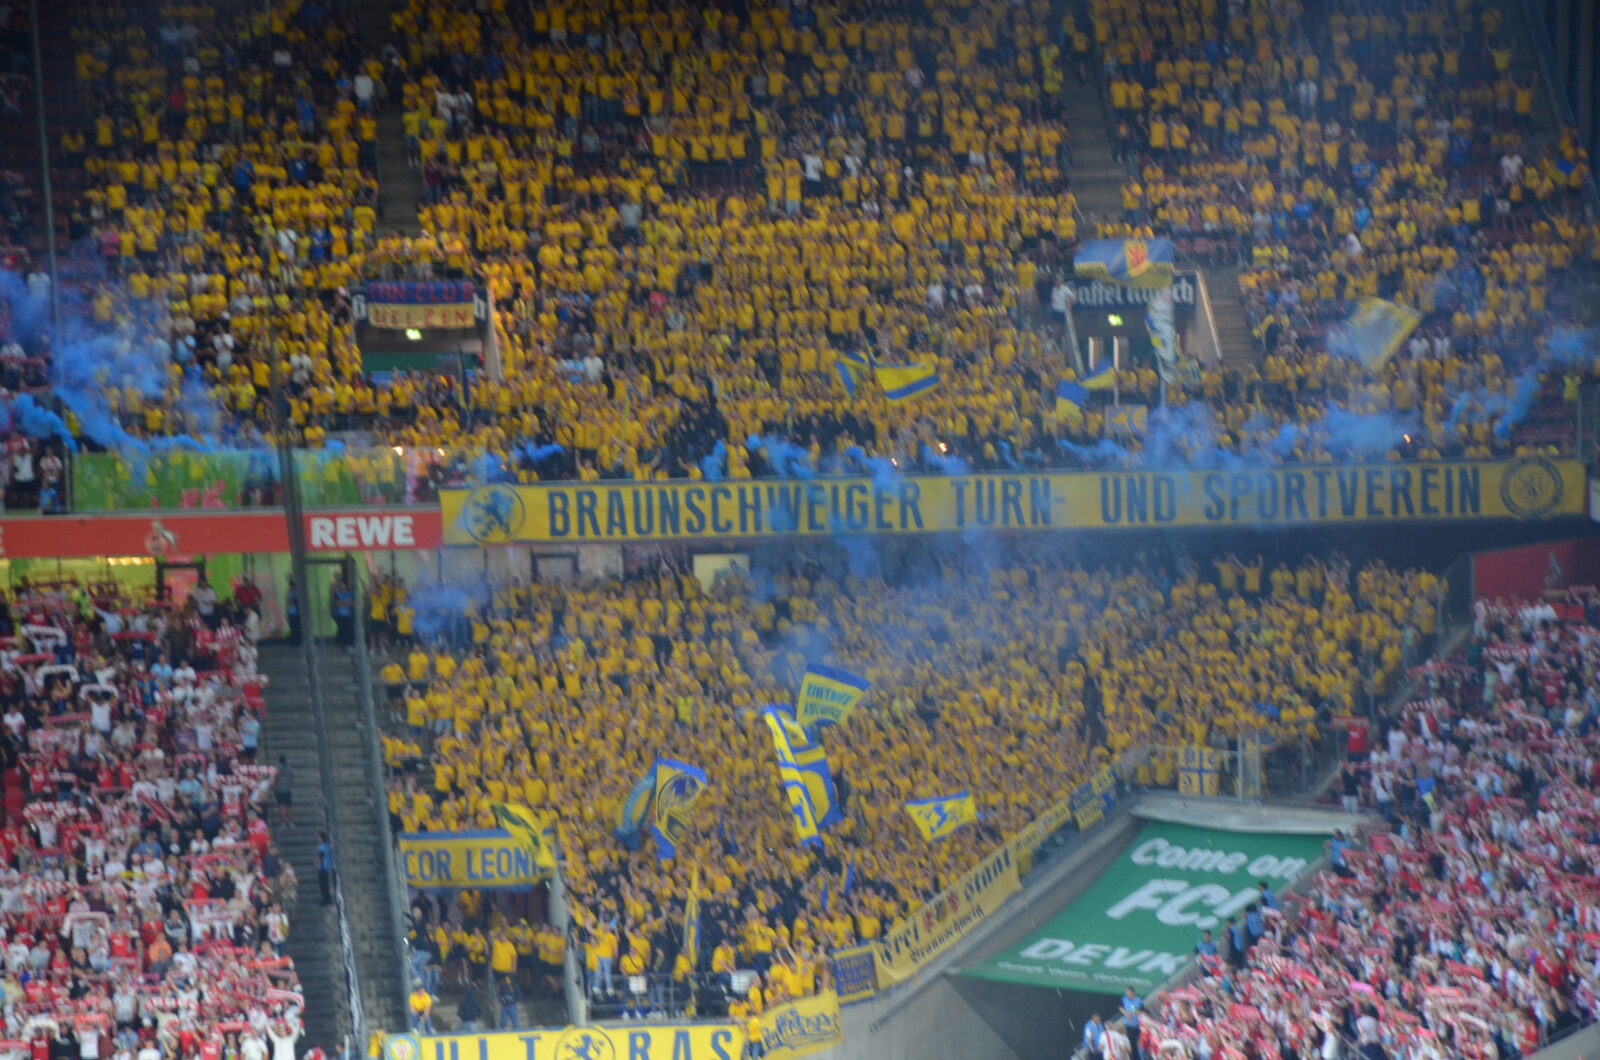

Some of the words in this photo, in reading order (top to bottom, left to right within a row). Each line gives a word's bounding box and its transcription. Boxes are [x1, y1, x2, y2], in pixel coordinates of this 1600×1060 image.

[547, 477, 925, 538] BRAUNSCHWEIGER
[951, 475, 1066, 529] TURN-
[1101, 472, 1177, 524] UND
[1203, 465, 1481, 521] SPORTVEREIN
[310, 515, 415, 548] REWE
[403, 849, 453, 881] COR
[1131, 837, 1248, 874] Come
[1247, 854, 1307, 879] on
[1105, 878, 1262, 929] FC!
[1018, 937, 1190, 976] DEVK
